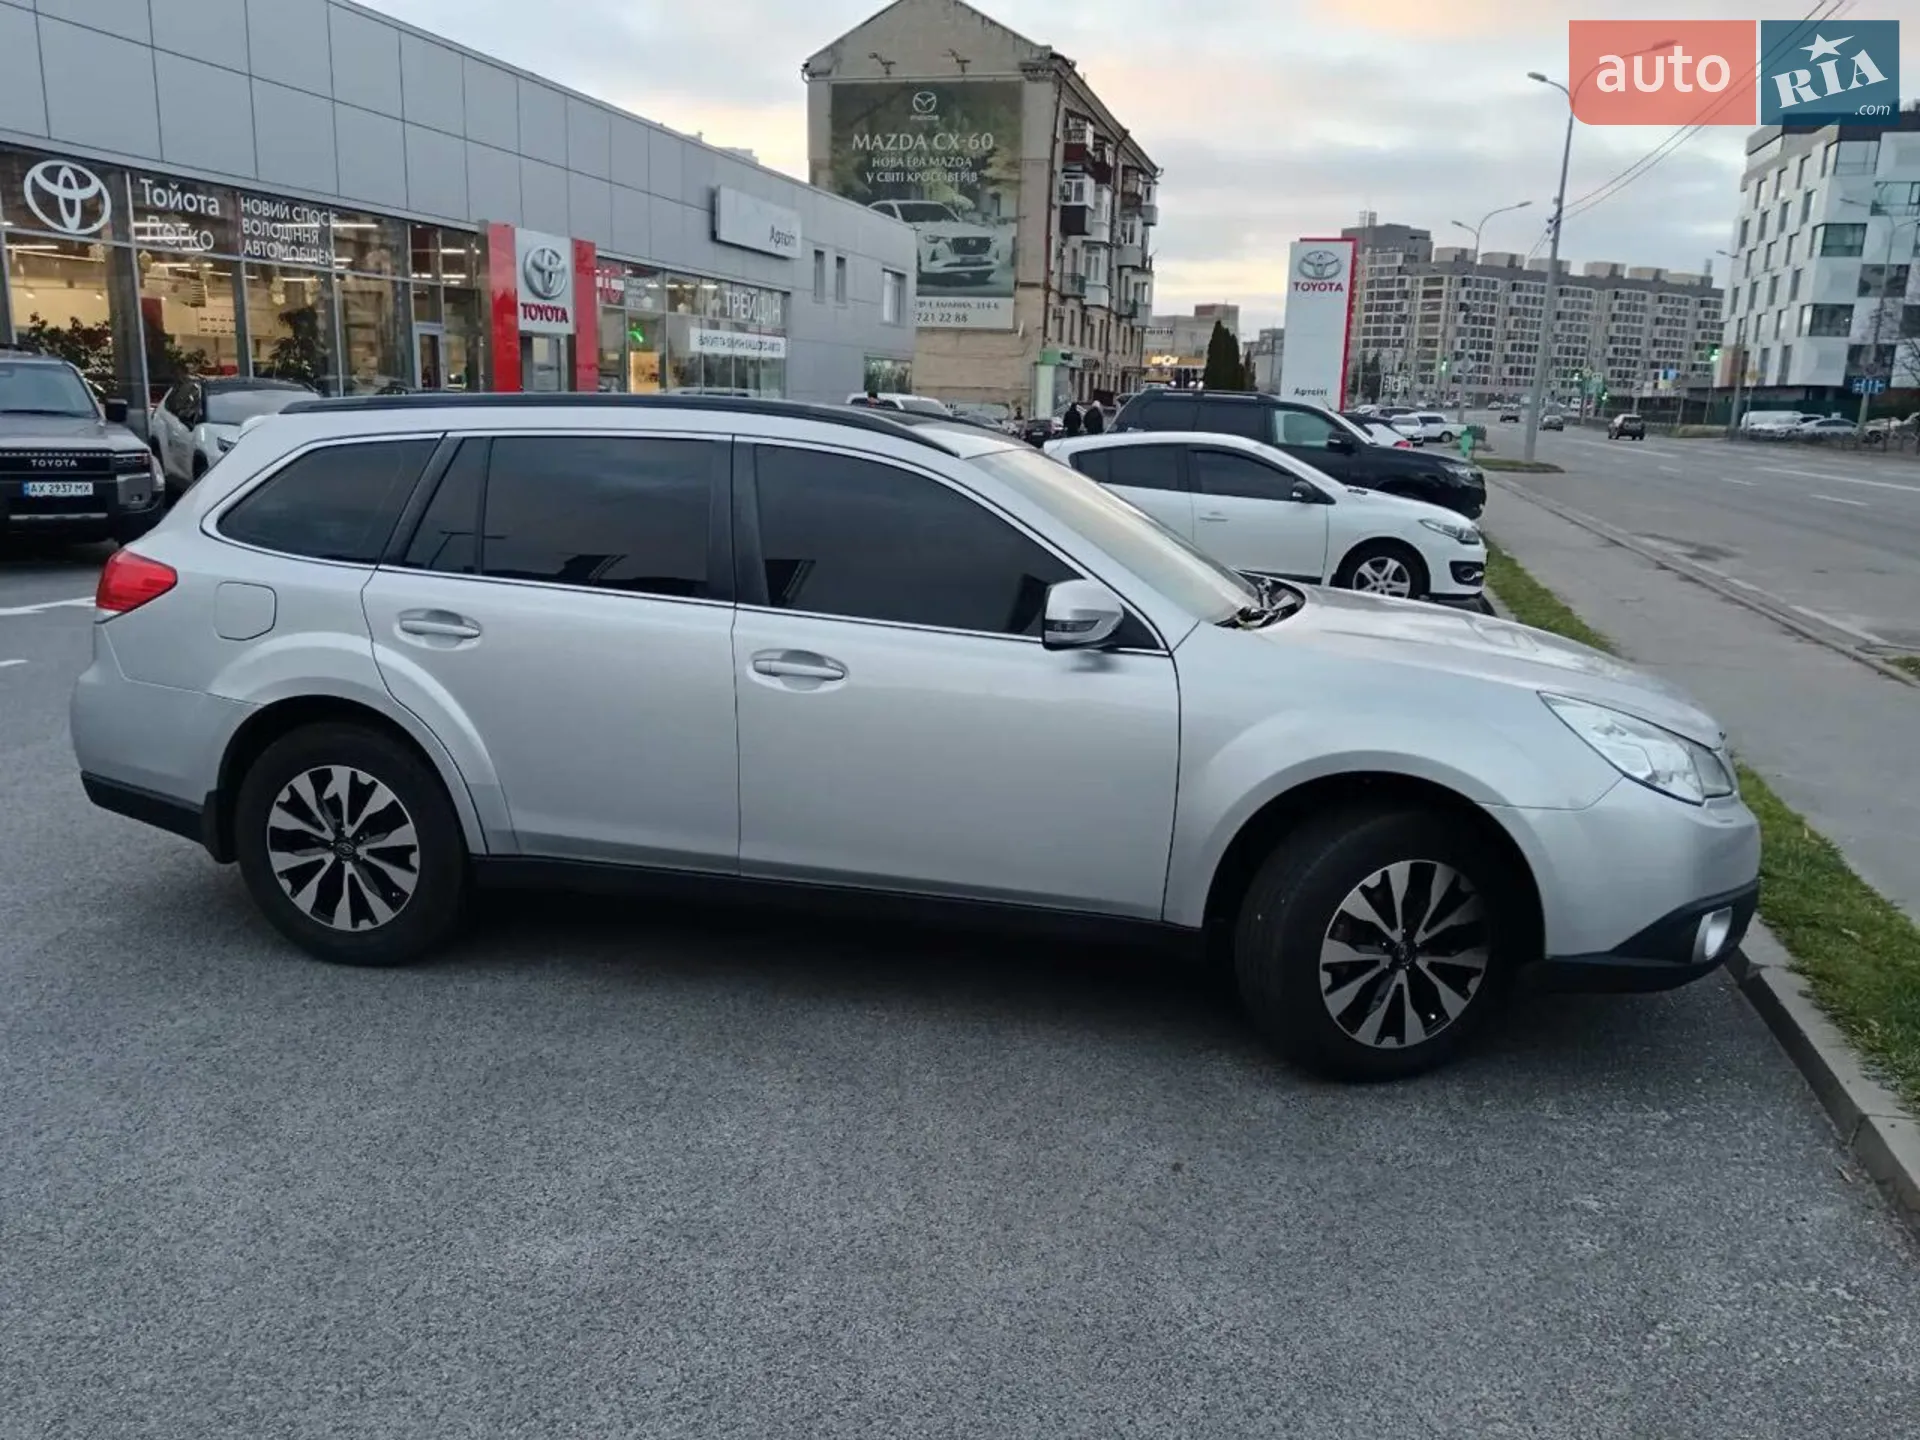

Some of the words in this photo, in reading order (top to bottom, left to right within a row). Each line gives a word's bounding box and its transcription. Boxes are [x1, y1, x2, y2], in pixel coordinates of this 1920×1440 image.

[851, 132, 927, 151] MAZDA
[932, 131, 994, 151] CX-60
[140, 177, 220, 217] Тойота
[240, 197, 290, 219] НОВИЙ
[241, 218, 320, 245] ВОЛОДІННЯ
[1293, 281, 1344, 293] TOYOTA
[520, 302, 570, 324] TOYOTA
[31, 459, 78, 467] TOYOTA
